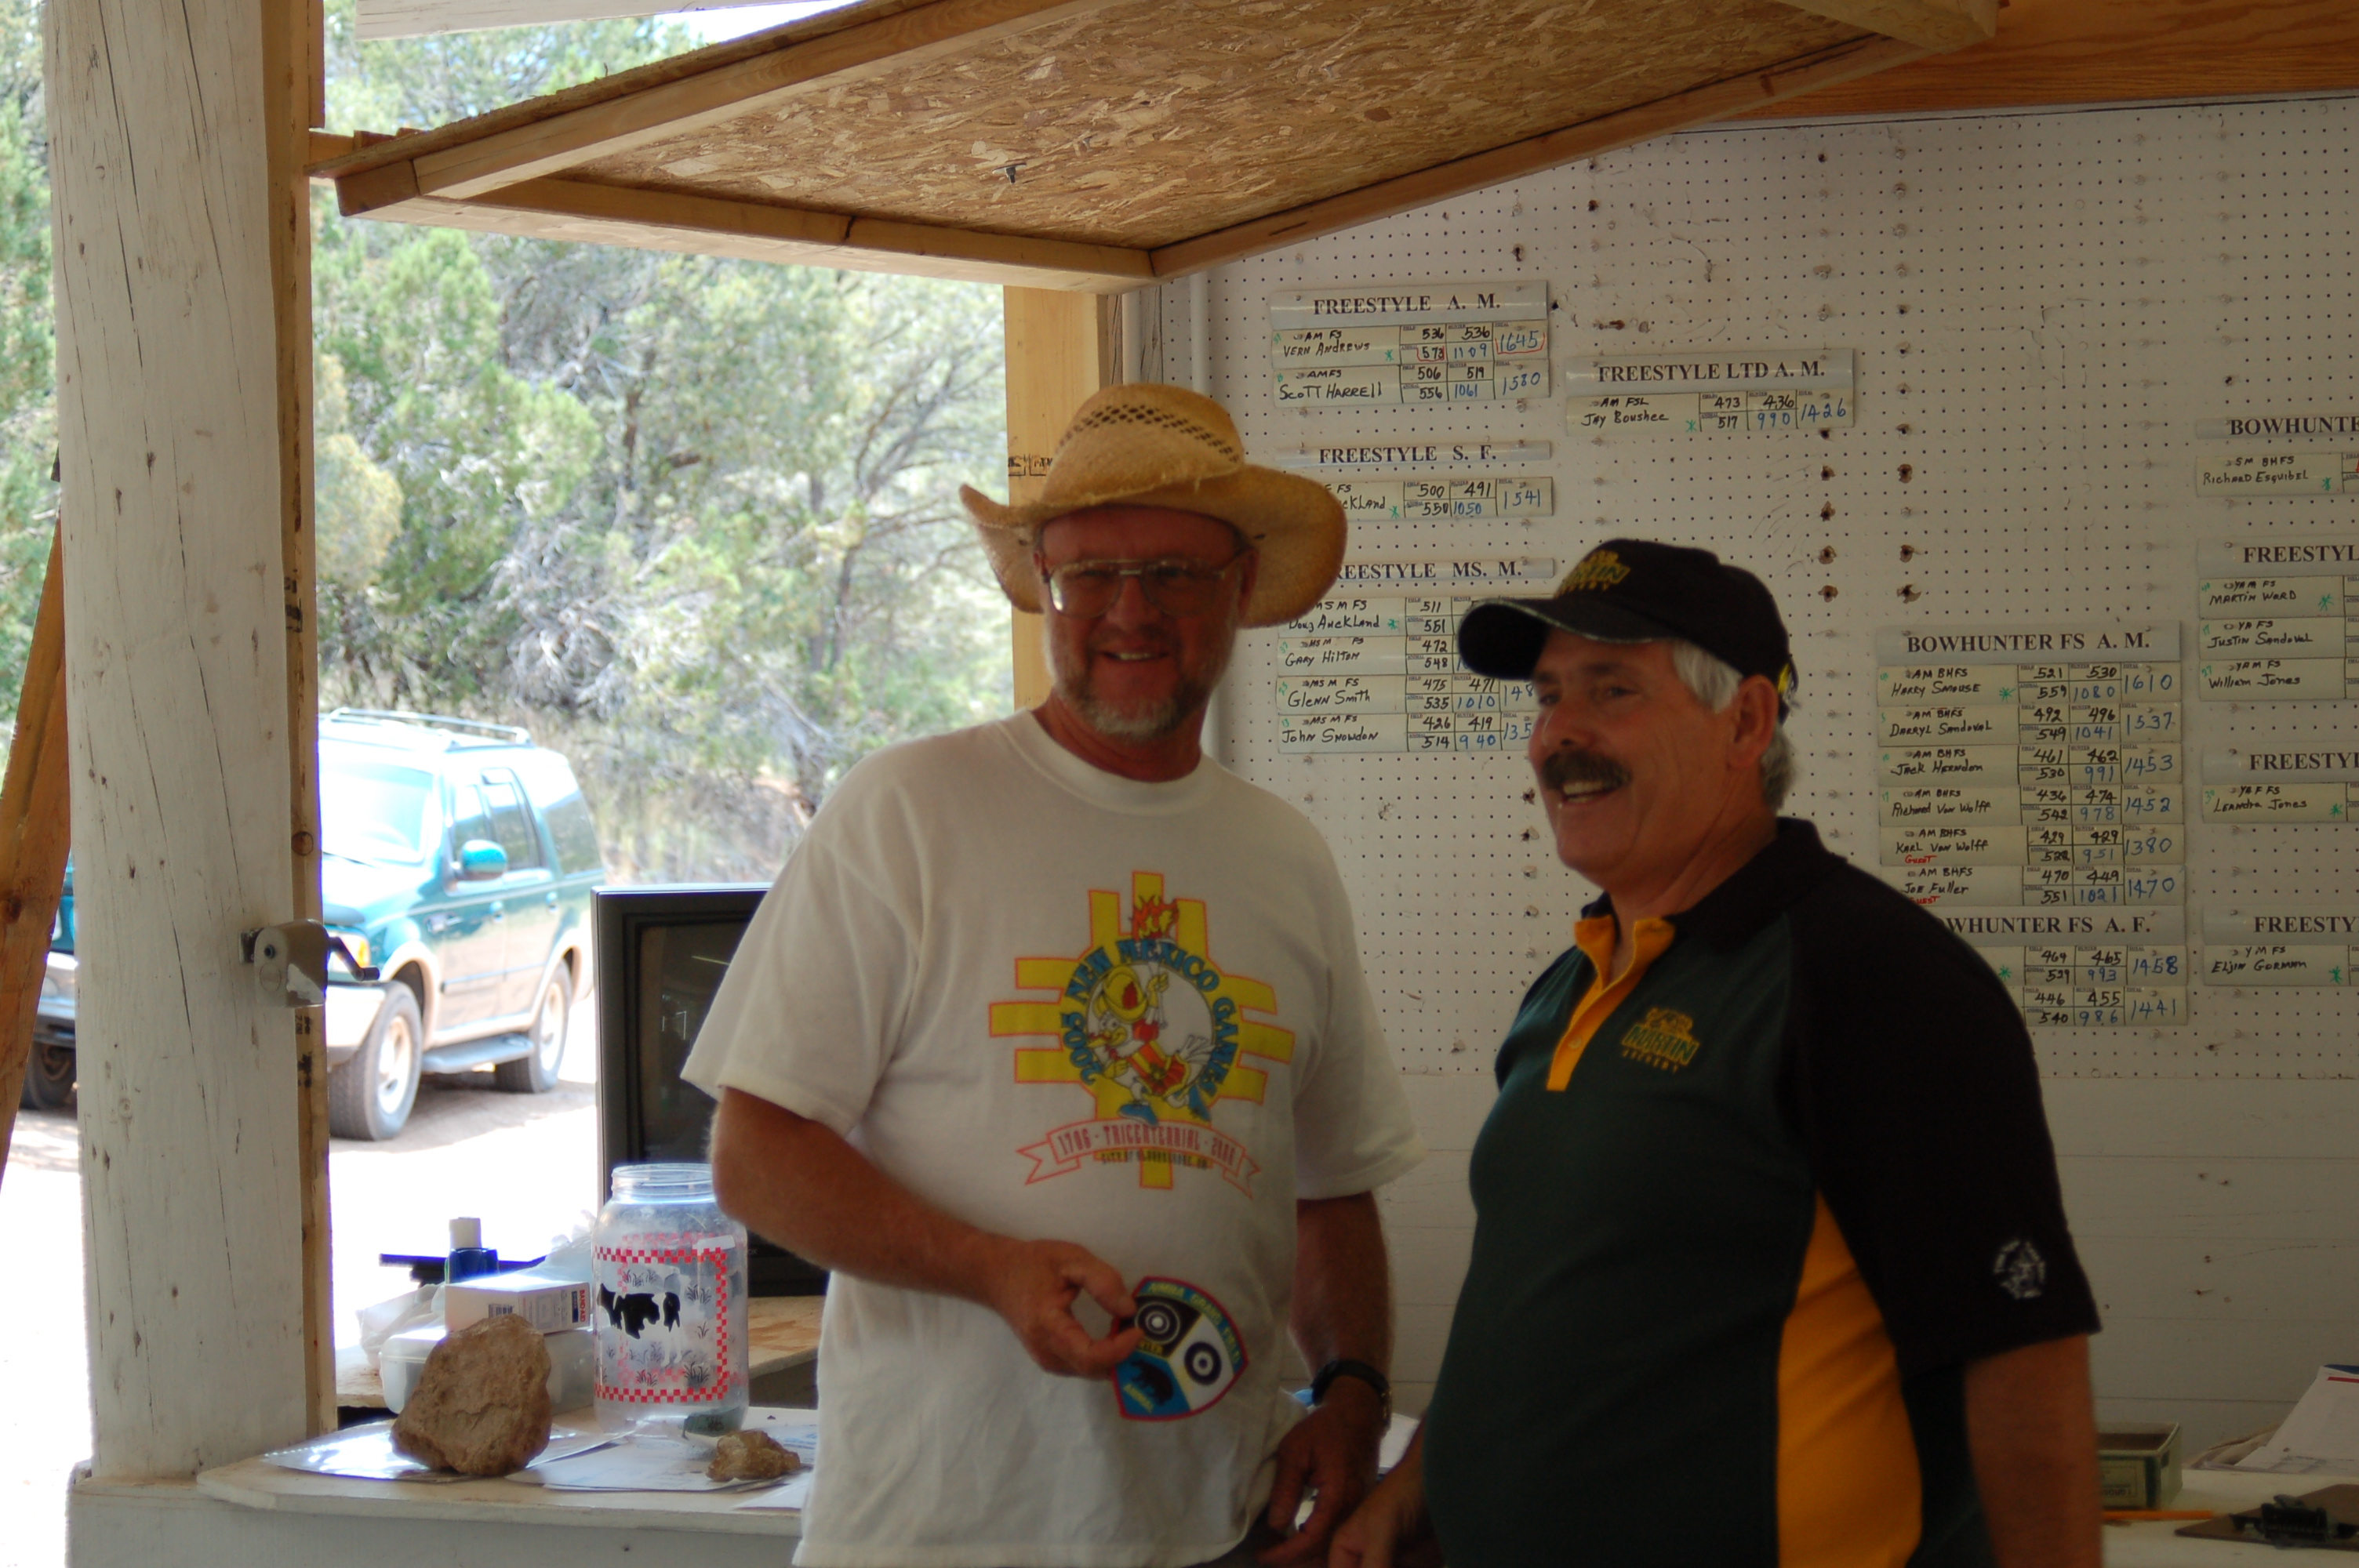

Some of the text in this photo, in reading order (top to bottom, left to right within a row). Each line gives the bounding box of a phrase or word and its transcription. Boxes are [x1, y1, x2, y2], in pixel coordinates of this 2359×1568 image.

[1314, 293, 1500, 315] FREESTYLE A. M.
[1304, 332, 1322, 342] AM
[1423, 326, 1490, 339] 536 536
[1423, 347, 1444, 358] 573
[1501, 331, 1539, 352] 1645
[1418, 367, 1484, 380] 506 519
[1598, 361, 1825, 383] FREESTYLE LTD A. M.
[1419, 372, 1540, 399] 556 1061 1580
[1714, 397, 1740, 408] 473
[1717, 415, 1737, 428] 517
[1801, 398, 1845, 422] 1426
[1319, 445, 1496, 463] FREESTYLE S. F.
[1418, 482, 1490, 497] 500 491
[1422, 489, 1540, 517] 550 1050 1541
[1452, 561, 1521, 577] MS. M.
[1420, 601, 1441, 612] 511
[1423, 640, 1447, 652] 472
[1907, 633, 2150, 652] BOWHUNTER FS A. M.
[1424, 658, 1448, 670] 548
[1911, 670, 1932, 680] AM
[2034, 666, 2117, 679] 521 530
[1423, 679, 1447, 691] 475
[2037, 685, 2066, 699] 559
[2125, 675, 2172, 694] 1610
[1424, 696, 1448, 710] 535
[1504, 684, 1533, 706] 148
[2034, 707, 2115, 723] 492 496
[1423, 717, 1492, 731] 426 419
[2036, 712, 2172, 741] 549 1041 1537
[1422, 735, 1450, 749] 514
[2034, 749, 2118, 764] 461 462
[2036, 755, 2172, 783] 530 991 1453
[2037, 789, 2117, 804] 436 474
[2081, 807, 2114, 822] 978
[2125, 797, 2170, 815] 1452
[2041, 830, 2118, 844] 429 429
[2083, 849, 2113, 862] 951
[2125, 837, 2172, 855] 1380
[2042, 870, 2118, 885] 470 449
[2041, 890, 2066, 904] 551
[2128, 878, 2174, 898] 1470
[1946, 916, 2150, 933] WHUNTER FS A. F.
[2041, 950, 2122, 965] 469 465
[2035, 991, 2121, 1006] 446 455
[1066, 947, 1114, 1005] NEW
[1116, 938, 1219, 993] MEXICO
[1201, 996, 1239, 1096] GAMES
[2039, 1012, 2068, 1025] 540
[2131, 999, 2175, 1020] 1441
